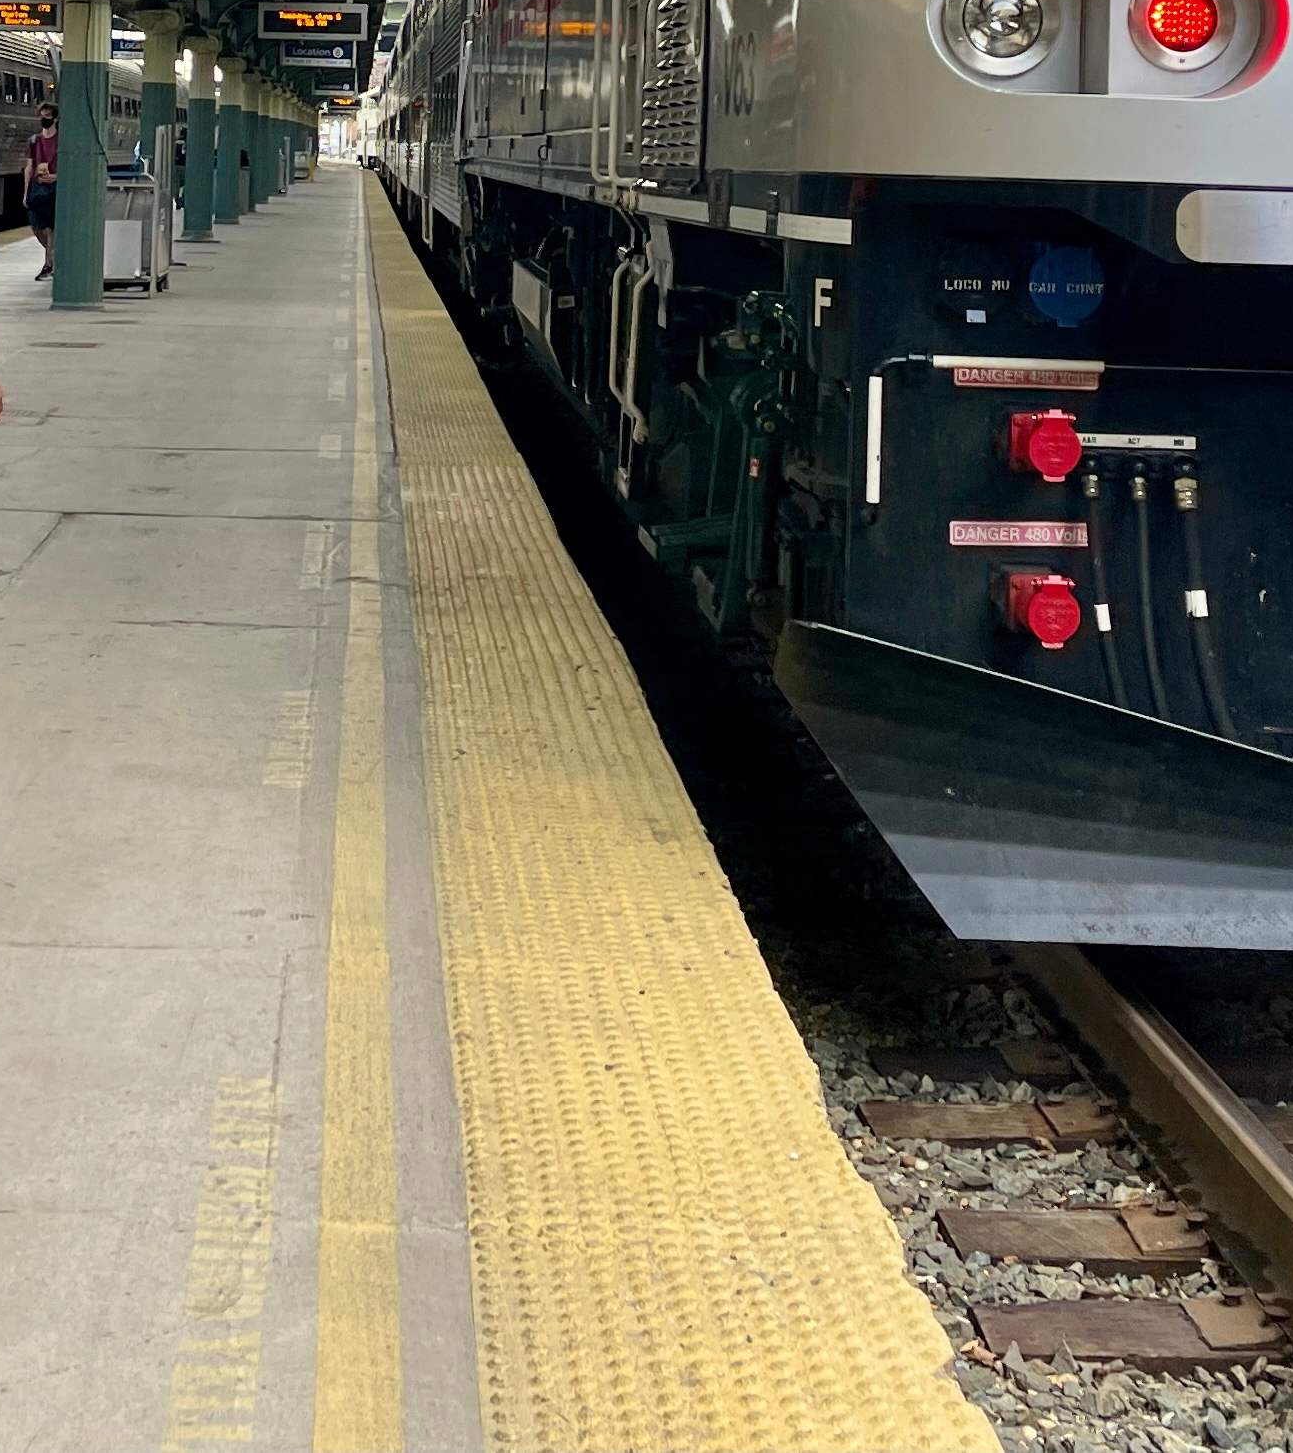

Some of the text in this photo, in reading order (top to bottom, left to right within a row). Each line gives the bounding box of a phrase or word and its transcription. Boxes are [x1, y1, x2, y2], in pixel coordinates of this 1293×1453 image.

[292, 47, 331, 57] Location
[944, 279, 1010, 291] LOCO MU
[814, 278, 833, 327] F
[957, 368, 1024, 382] DANGER
[955, 527, 1020, 541] DANGER
[1024, 528, 1050, 541] 480
